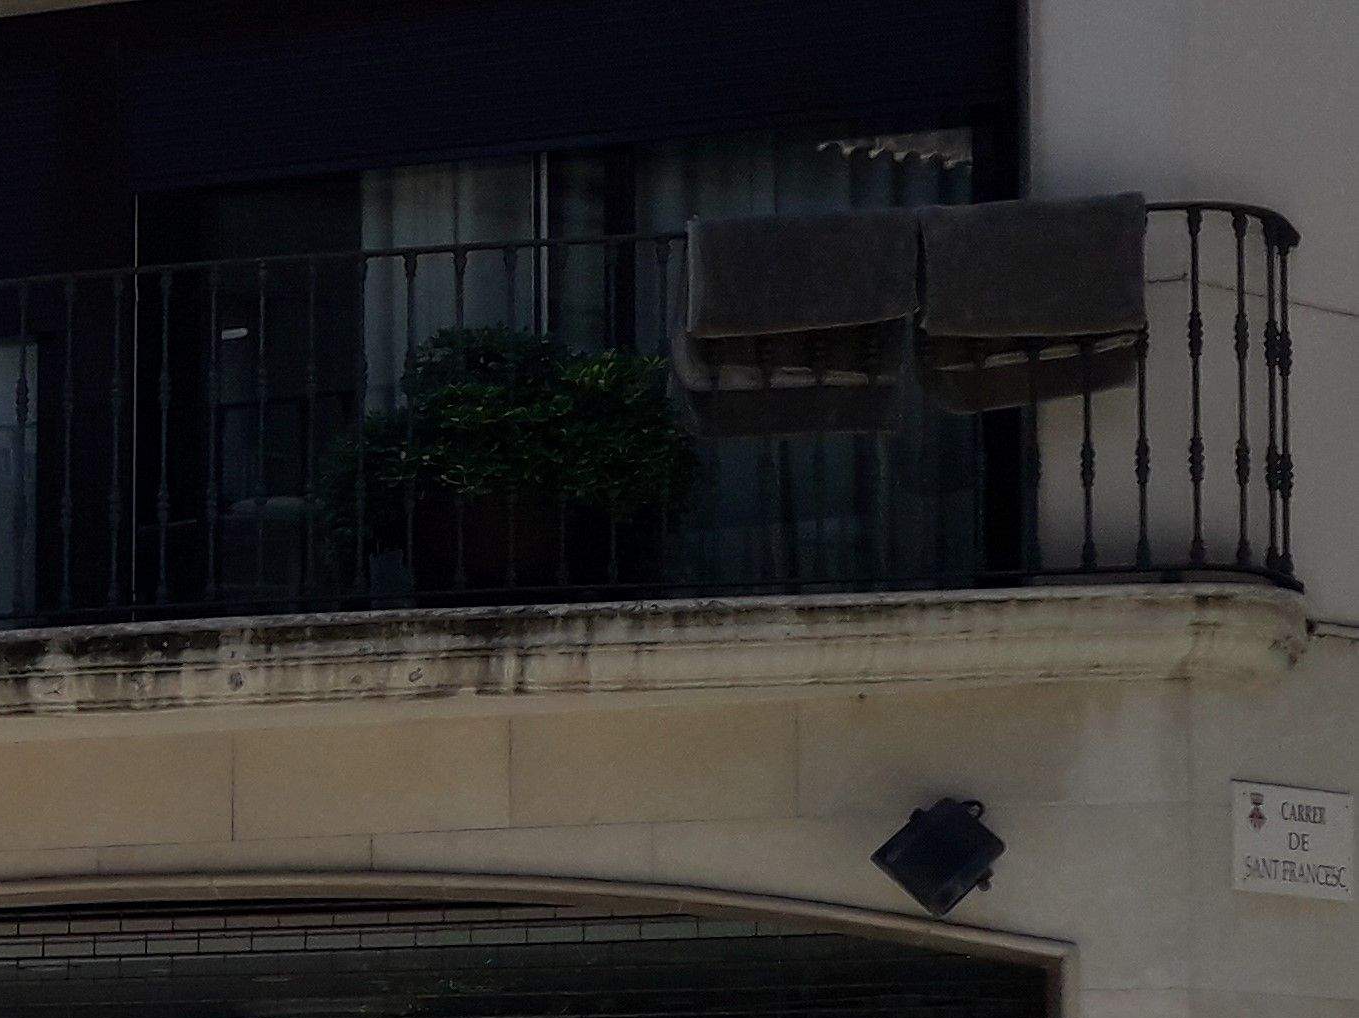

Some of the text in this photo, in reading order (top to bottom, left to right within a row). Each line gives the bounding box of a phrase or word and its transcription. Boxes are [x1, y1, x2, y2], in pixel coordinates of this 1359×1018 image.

[1281, 801, 1326, 825] CARRER
[1288, 832, 1310, 852] DE
[1245, 856, 1347, 888] SANT FRANCESC
